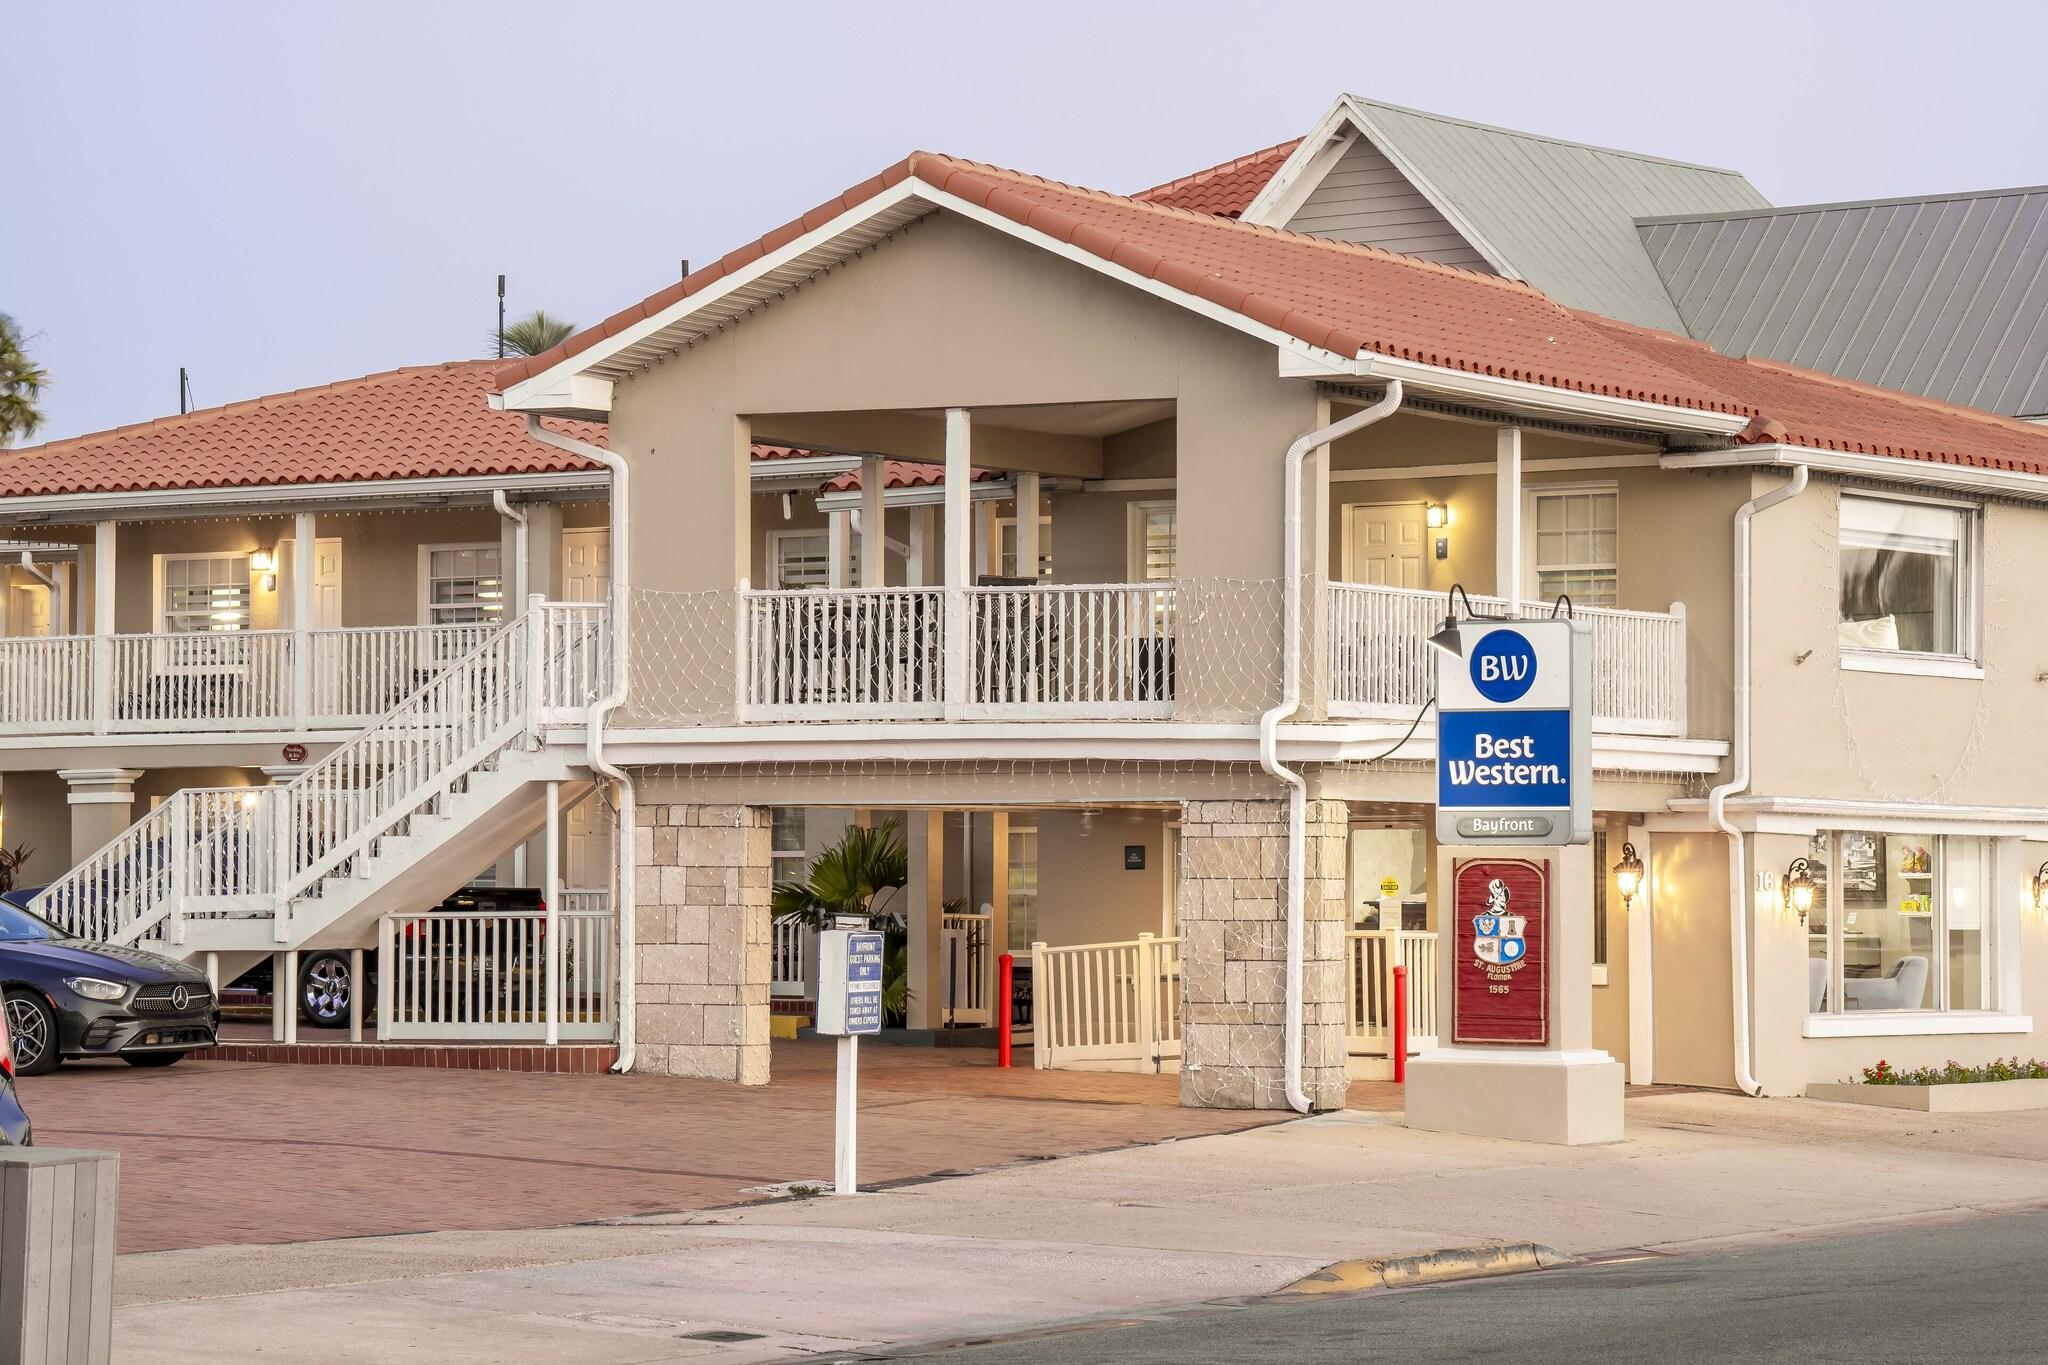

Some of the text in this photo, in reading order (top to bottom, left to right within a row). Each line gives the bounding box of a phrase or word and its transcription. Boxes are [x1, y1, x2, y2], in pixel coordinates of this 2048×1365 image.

[1481, 655, 1528, 681] BW
[1476, 733, 1535, 758] Best
[1473, 818, 1534, 834] Bayfront
[856, 942, 875, 952] BAYFRONT
[850, 954, 880, 964] GUEST PARKING
[859, 966, 870, 976] ONLY
[1473, 959, 1527, 973] ST. AUGUSTINE
[1488, 985, 1509, 994] 1565
[850, 996, 863, 1005] OTHERS
[864, 996, 872, 1004] WILL
[862, 1006, 872, 1014] AWAY
